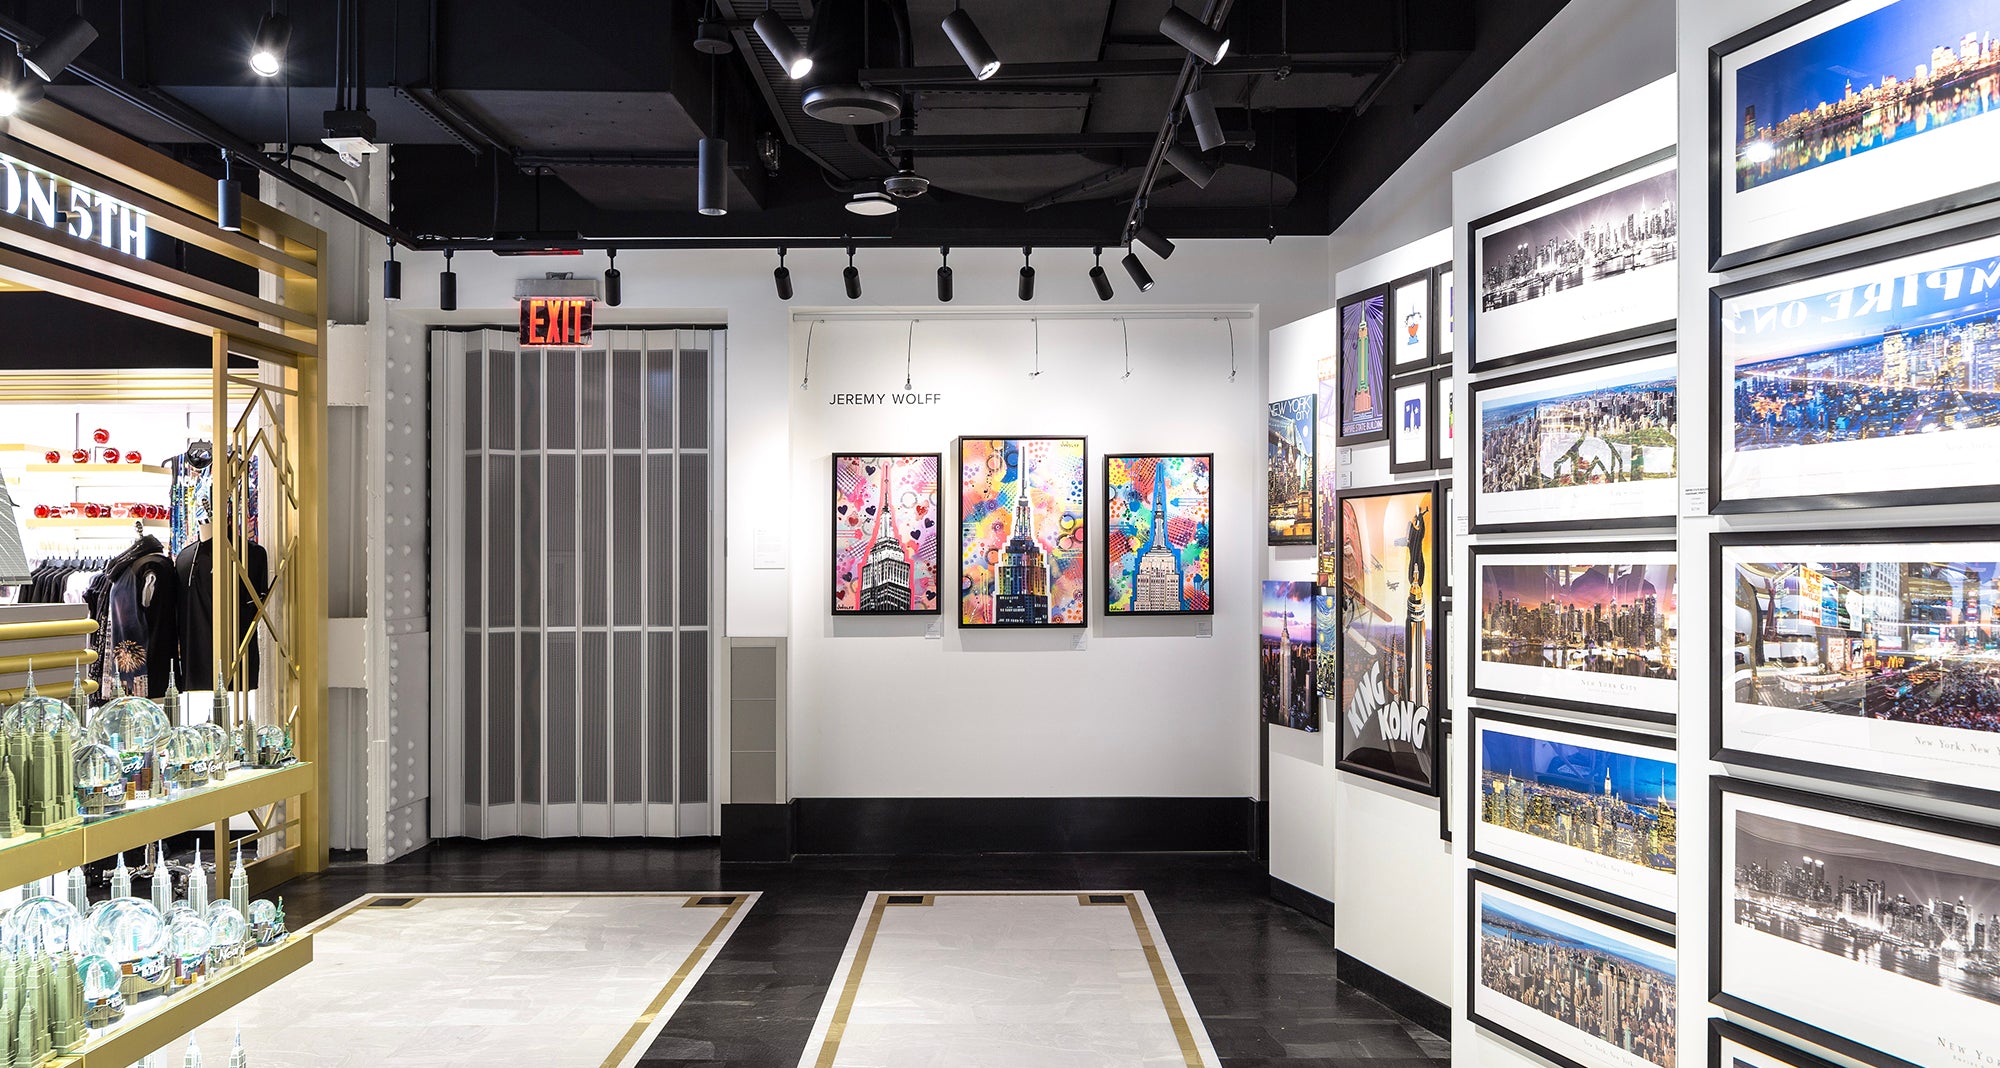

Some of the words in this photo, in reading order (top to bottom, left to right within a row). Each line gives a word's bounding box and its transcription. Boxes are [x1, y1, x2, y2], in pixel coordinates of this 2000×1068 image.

[69, 187, 146, 260] 5TH
[529, 299, 586, 344] EXIT
[829, 393, 886, 405] JEREMY
[892, 393, 941, 405] WOLFF
[1288, 396, 1311, 413] YORK
[1296, 409, 1310, 420] CITY
[1348, 661, 1385, 739] KING
[1378, 701, 1428, 749] KONG
[1915, 736, 1933, 746] New
[1939, 739, 1966, 752] York,
[1971, 743, 1989, 753] New
